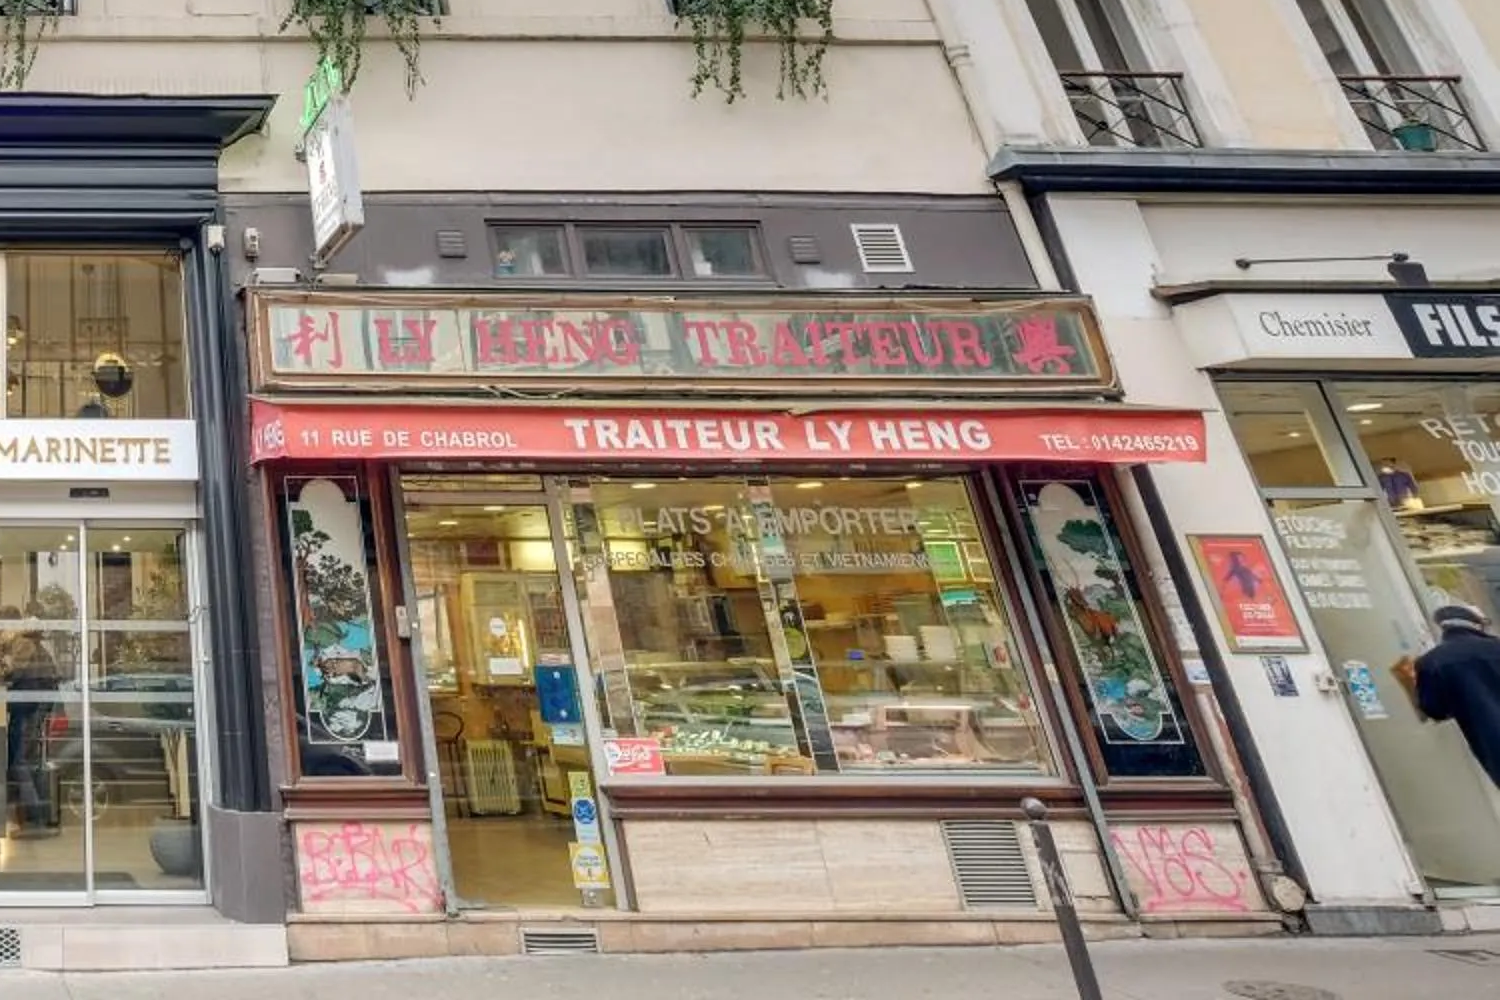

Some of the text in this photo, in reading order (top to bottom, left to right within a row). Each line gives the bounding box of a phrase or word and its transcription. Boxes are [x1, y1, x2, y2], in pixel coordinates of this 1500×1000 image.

[1259, 311, 1372, 336] Chemisier
[374, 318, 437, 364] LY
[475, 317, 642, 366] HENG
[684, 319, 992, 368] TRAITEUR
[300, 429, 518, 449] 11 RUE DE CHABROL
[564, 418, 992, 452] TRAITEUR LY HENG
